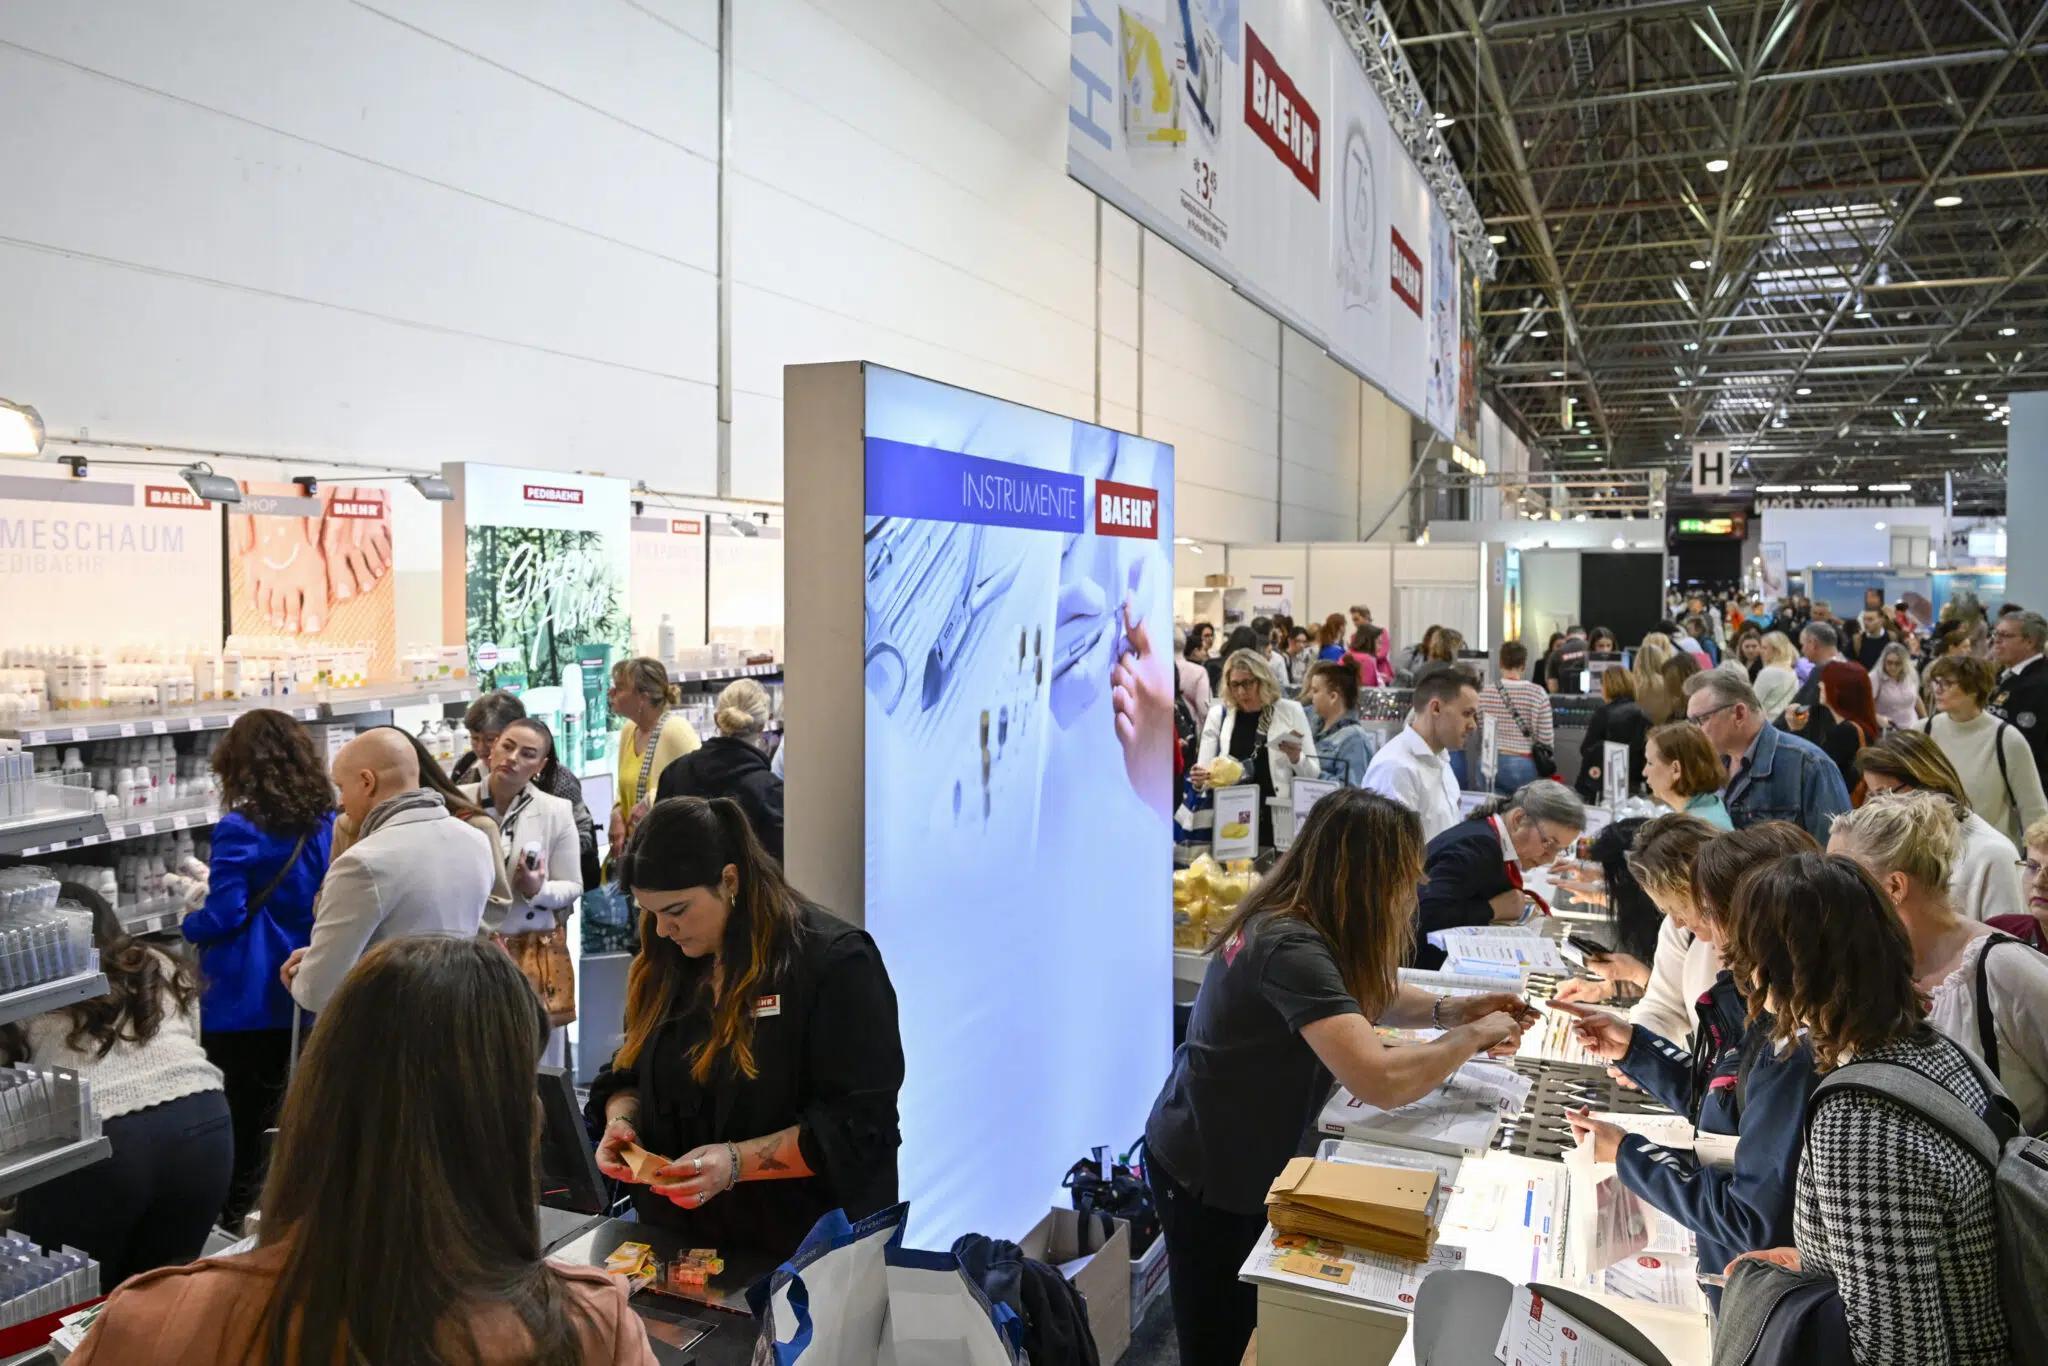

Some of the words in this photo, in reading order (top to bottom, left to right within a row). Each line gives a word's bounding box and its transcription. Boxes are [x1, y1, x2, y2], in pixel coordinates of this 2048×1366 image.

[1252, 57, 1315, 175] BAEHR
[1700, 451, 1724, 486] H
[333, 502, 378, 516] BAEHR
[527, 486, 581, 503] PEDIBAEHR
[962, 470, 1077, 520] INSTRUMENTE
[1100, 493, 1153, 529] BAEHR
